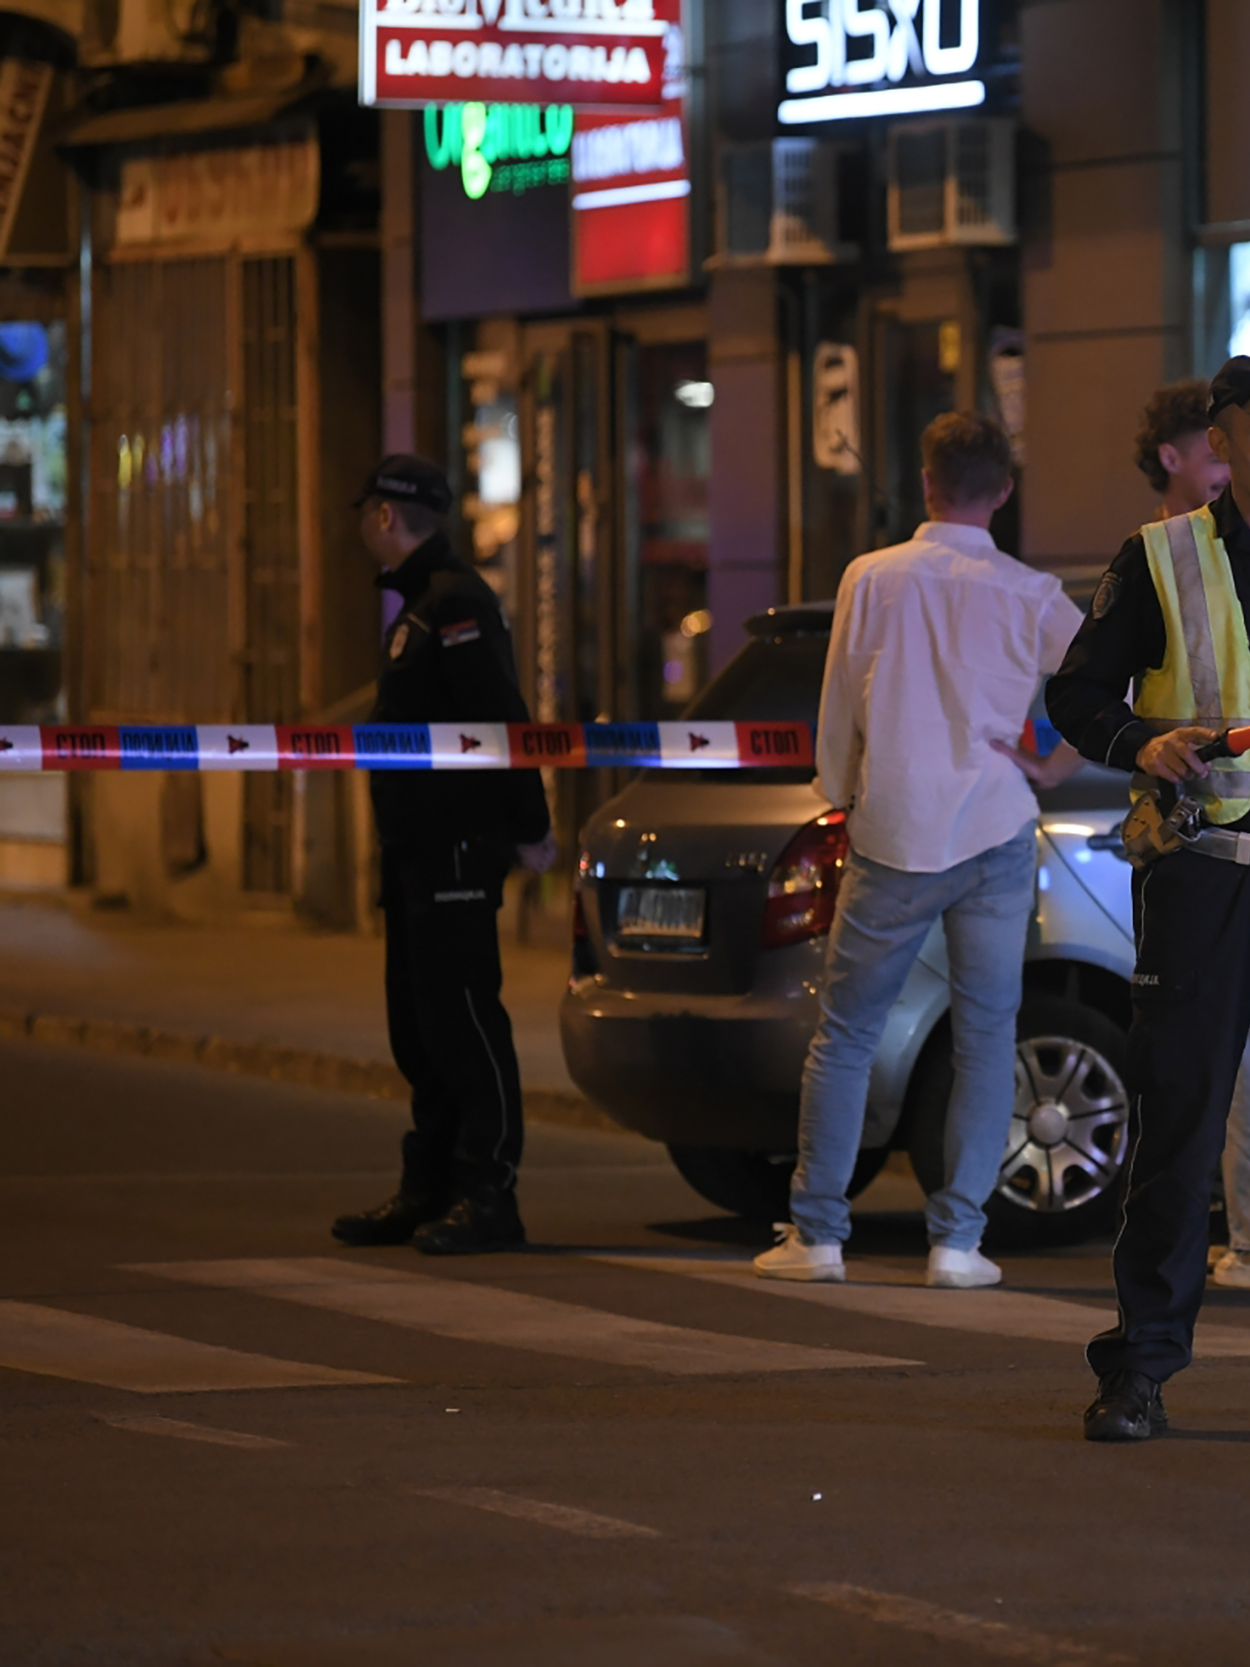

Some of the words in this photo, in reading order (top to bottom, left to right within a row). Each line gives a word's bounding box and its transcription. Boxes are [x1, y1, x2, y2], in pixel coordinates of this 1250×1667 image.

[385, 38, 651, 84] LABORATORIJA
[56, 732, 106, 759] СТОП
[291, 731, 340, 758] СТОП
[522, 730, 571, 756] СТОП
[750, 728, 799, 756] СТОП
